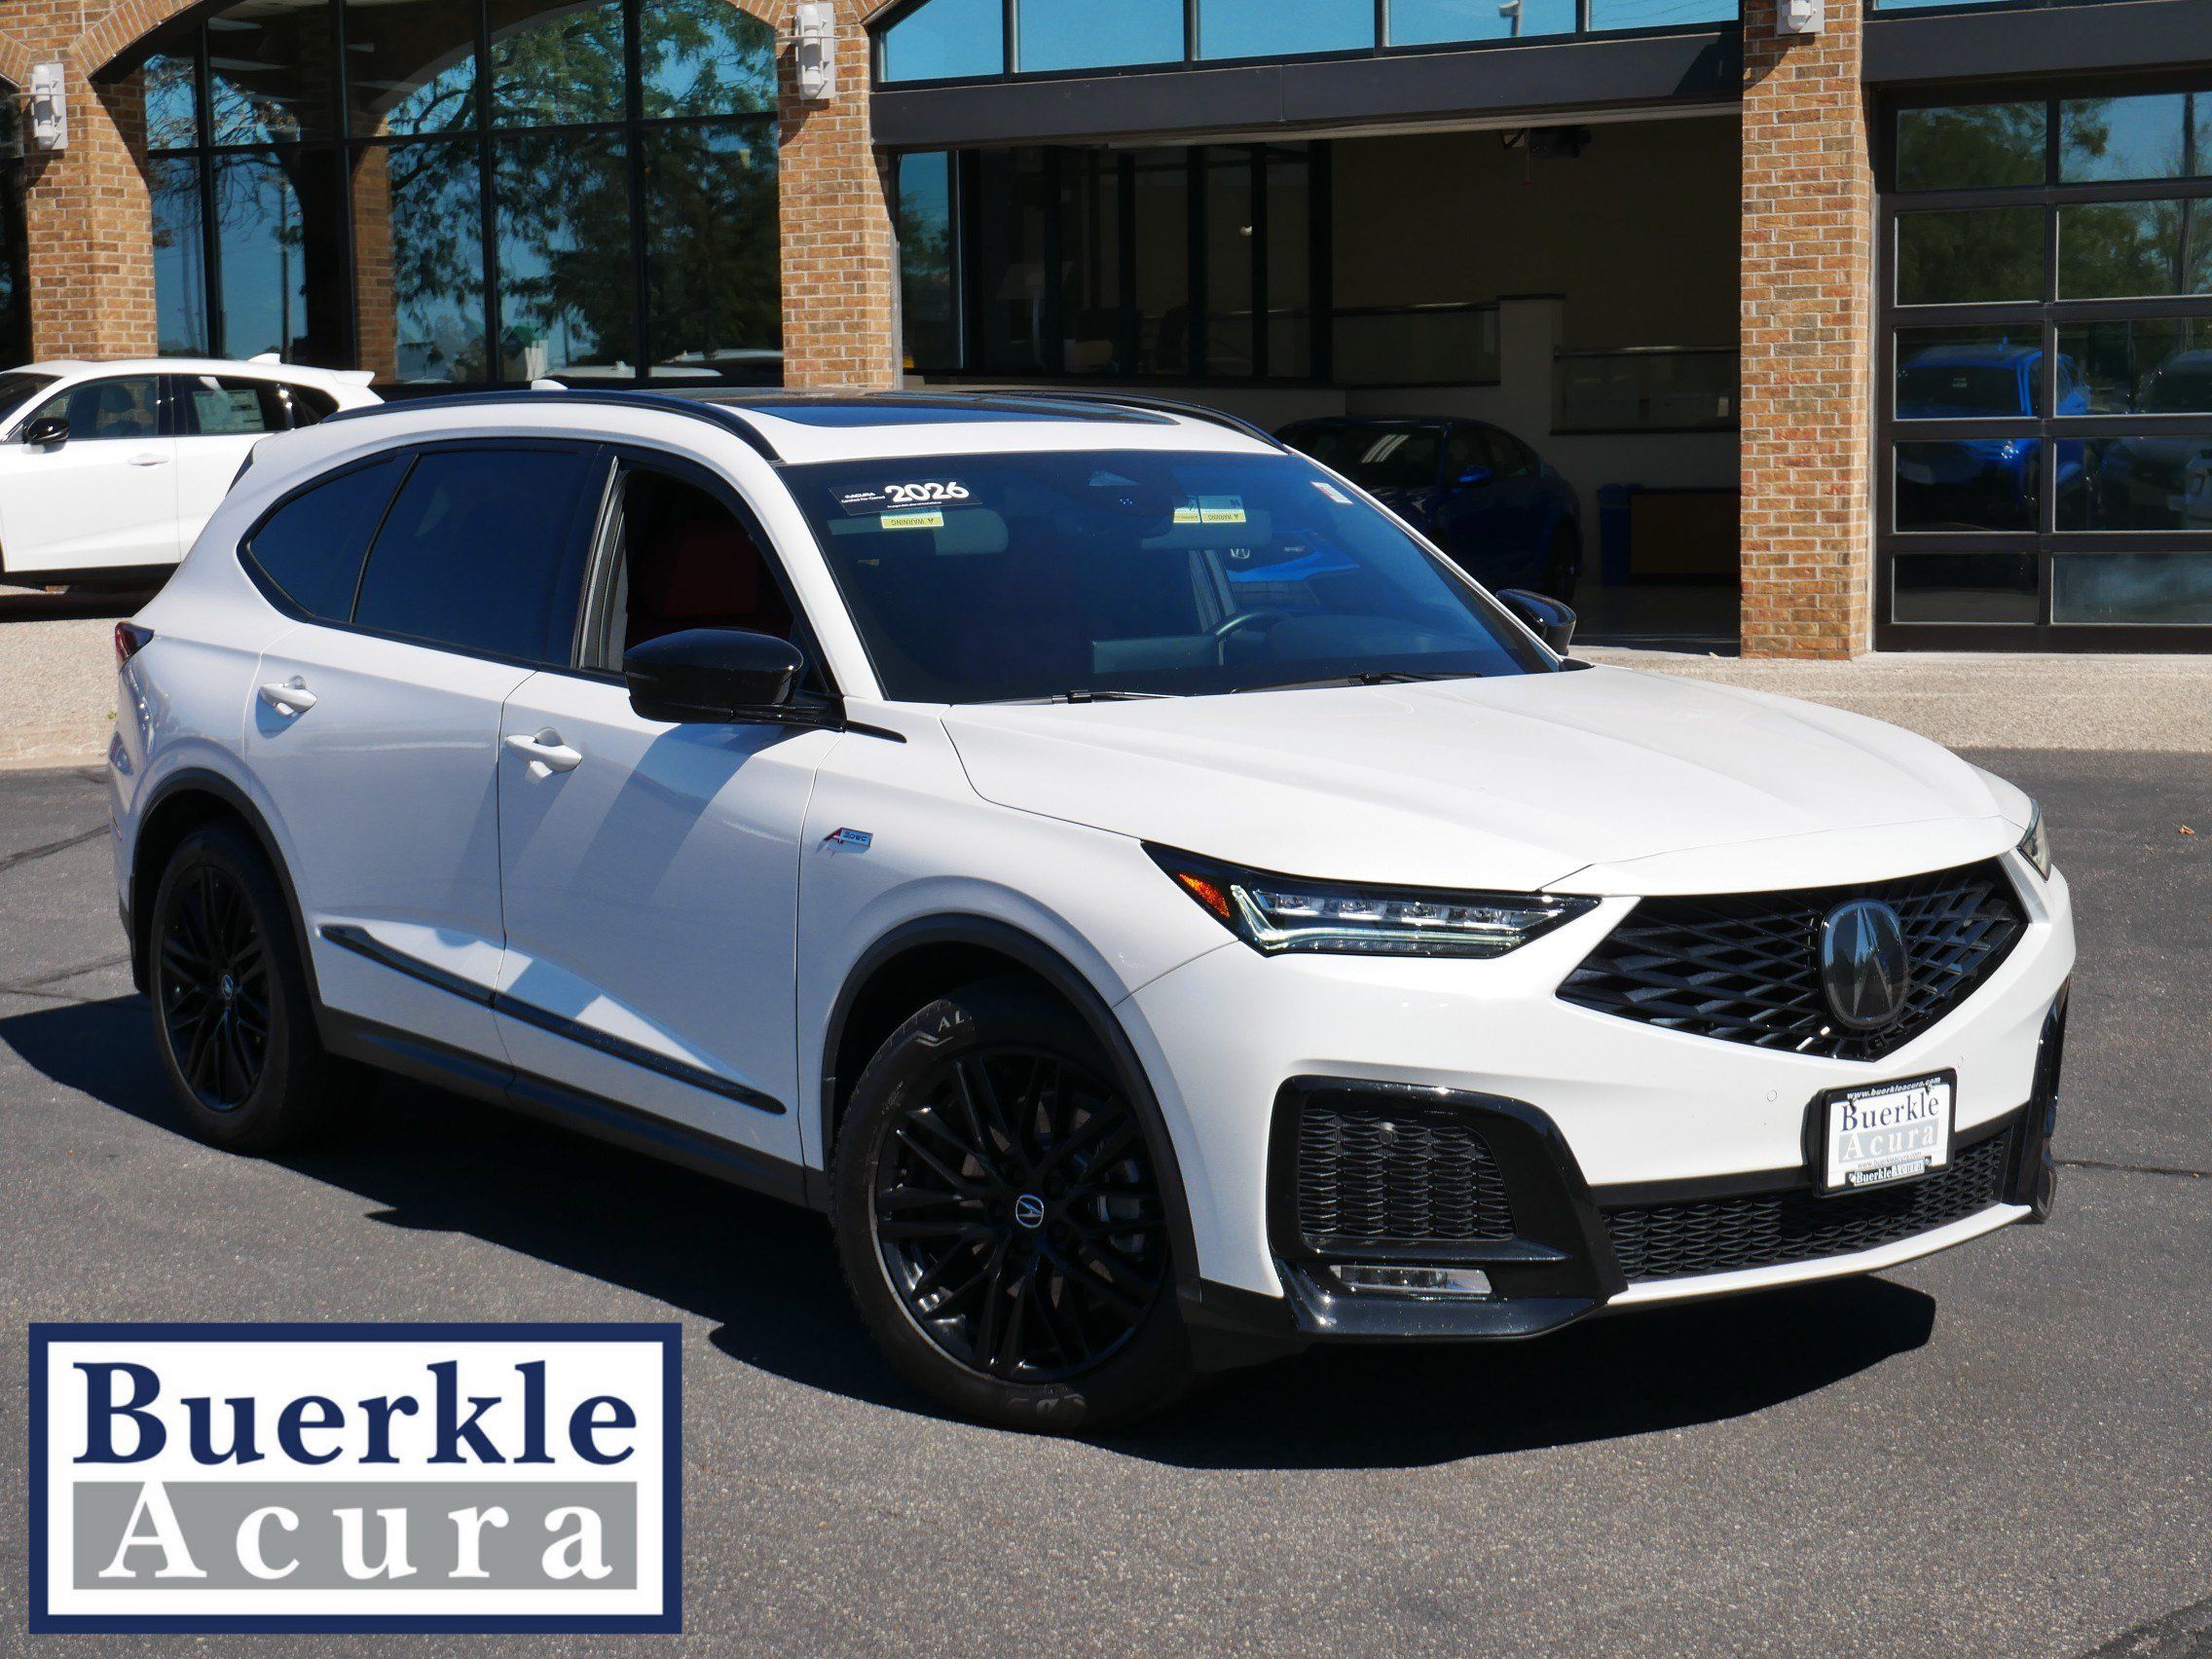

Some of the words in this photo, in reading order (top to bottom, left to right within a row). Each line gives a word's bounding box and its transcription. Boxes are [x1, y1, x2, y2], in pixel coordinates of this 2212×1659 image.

[885, 482, 970, 502] 2026
[891, 517, 925, 526] WARNING
[939, 1011, 966, 1032] AL
[1841, 1091, 1939, 1131] Buerkle
[1843, 1124, 1935, 1160] Acura
